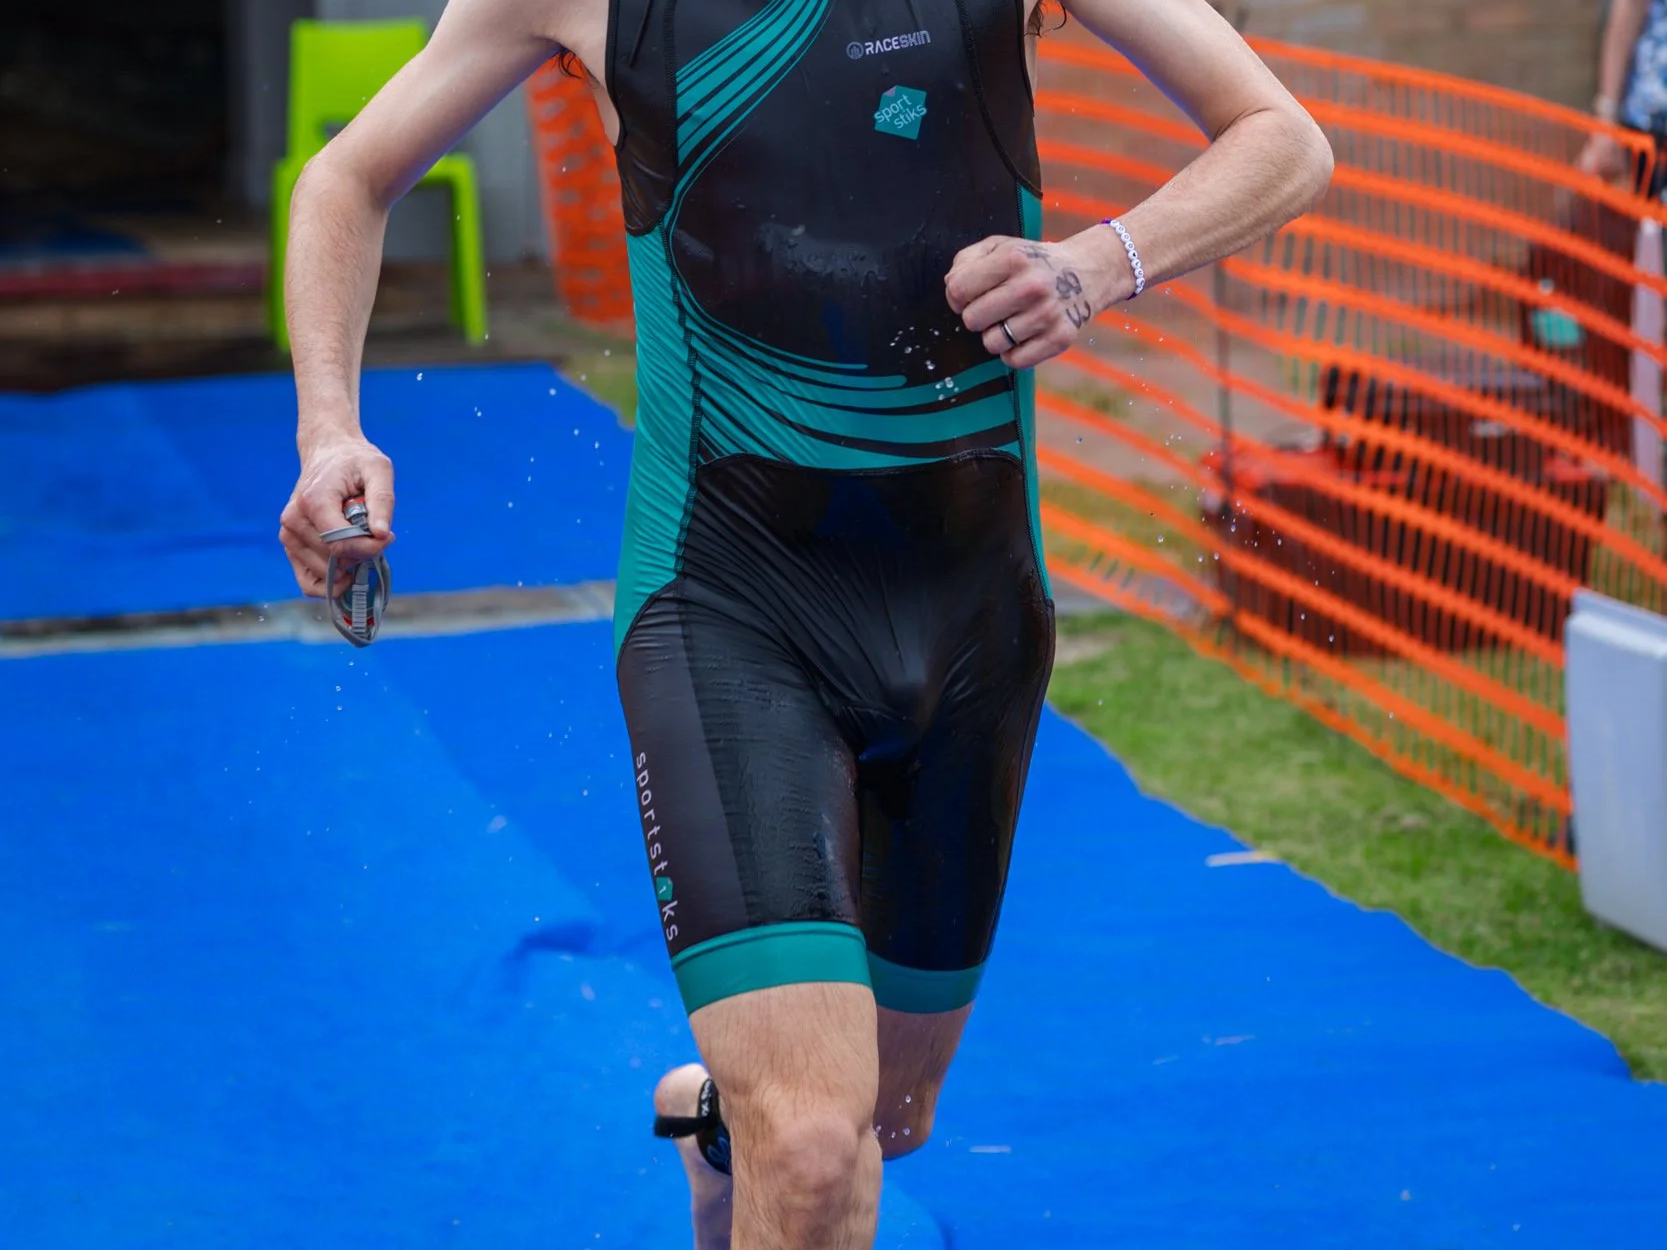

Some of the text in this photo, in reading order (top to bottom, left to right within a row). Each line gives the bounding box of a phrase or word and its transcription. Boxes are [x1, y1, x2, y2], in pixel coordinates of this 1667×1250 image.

[865, 30, 931, 55] RACESKIN
[874, 94, 912, 123] sport
[894, 104, 927, 129] stiks
